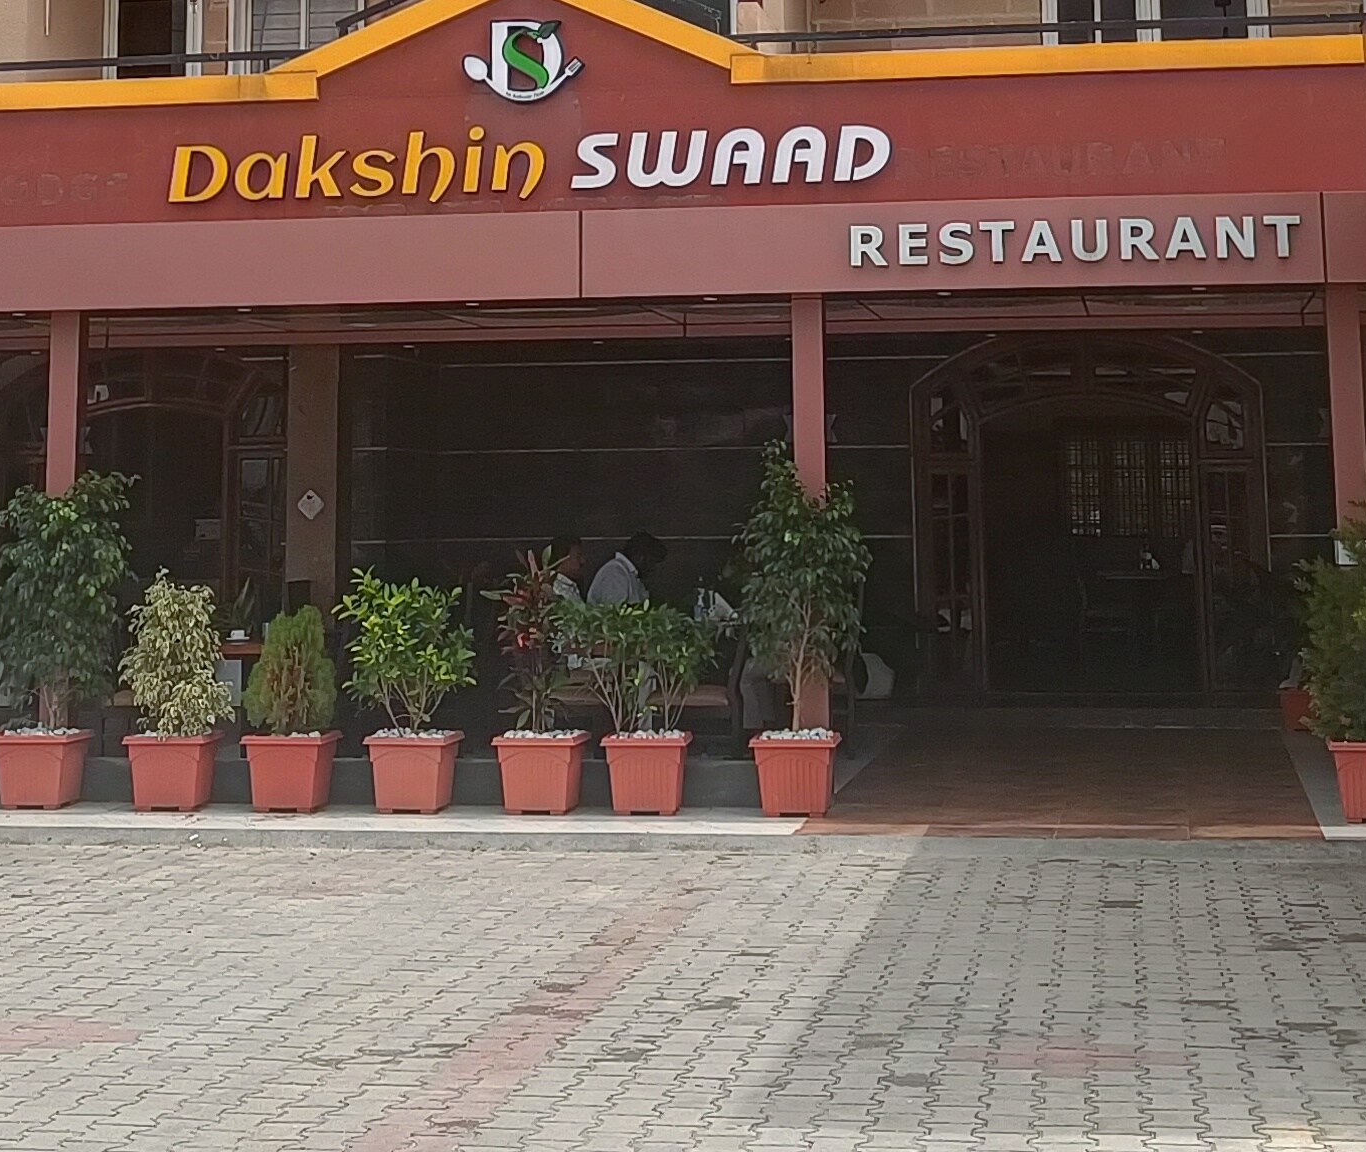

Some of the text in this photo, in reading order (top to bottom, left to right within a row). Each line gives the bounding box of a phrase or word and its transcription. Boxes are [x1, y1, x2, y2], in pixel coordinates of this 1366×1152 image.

[168, 125, 892, 203] Dakshin SWAAD
[849, 214, 1301, 267] RESTAURANT
